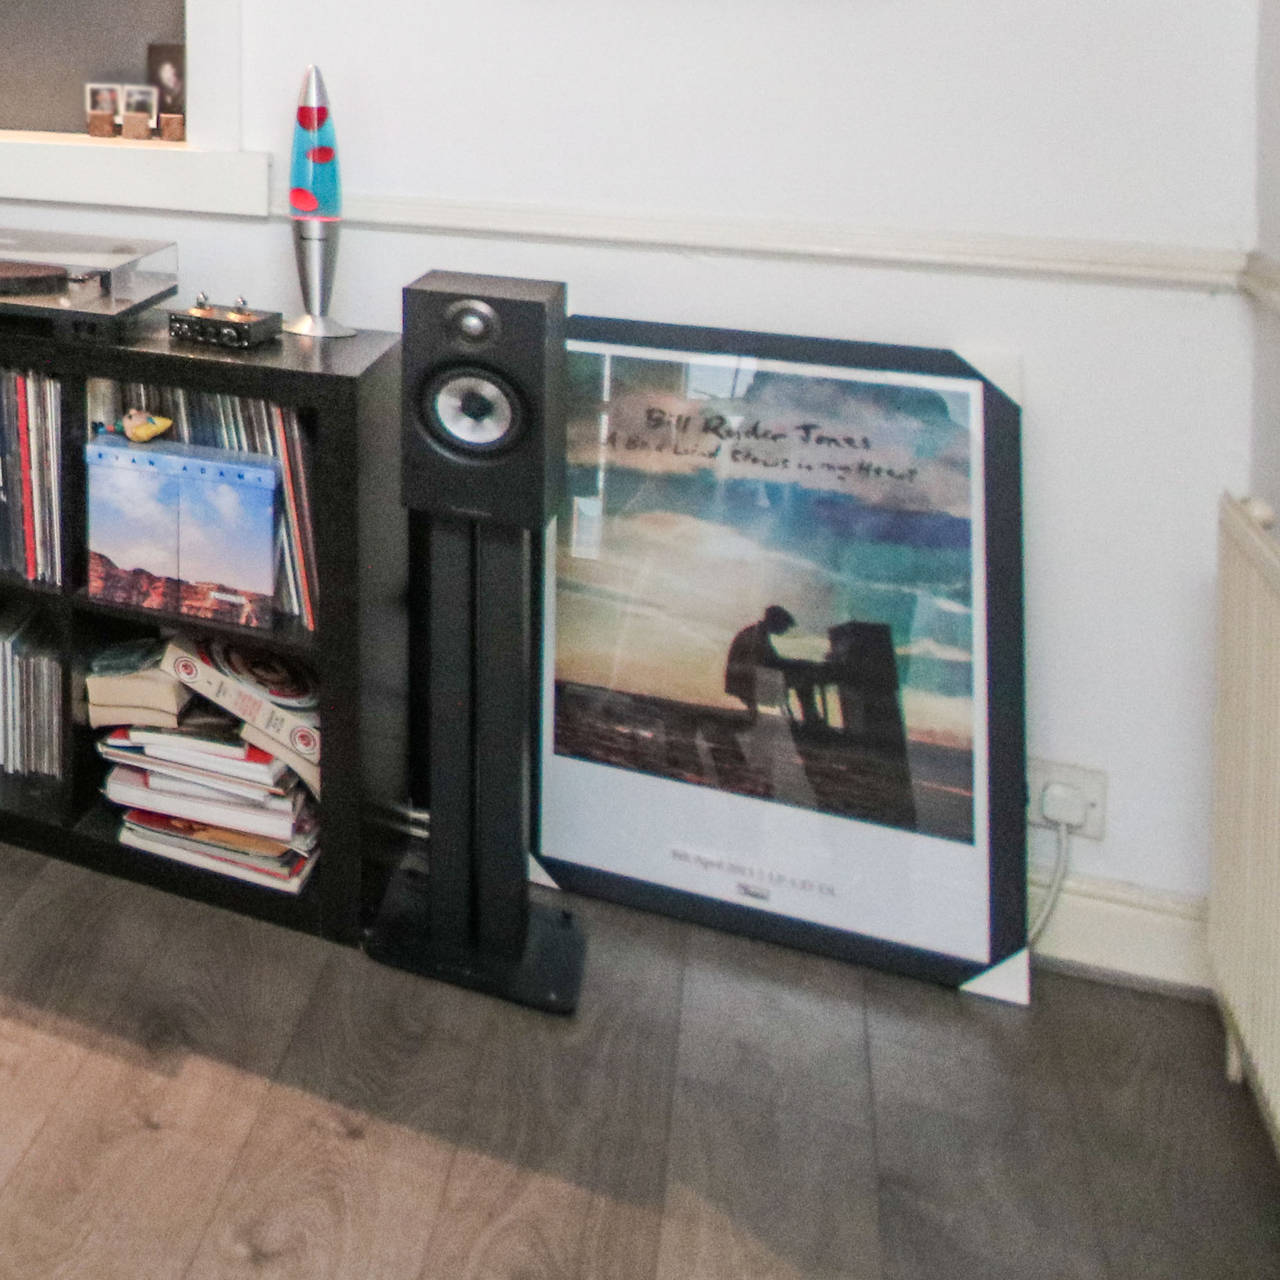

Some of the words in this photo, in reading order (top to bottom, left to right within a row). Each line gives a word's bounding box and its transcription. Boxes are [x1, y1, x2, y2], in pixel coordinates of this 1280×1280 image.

[646, 407, 691, 433] Bill
[796, 422, 872, 450] Jones
[181, 465, 263, 483] ADAMS
